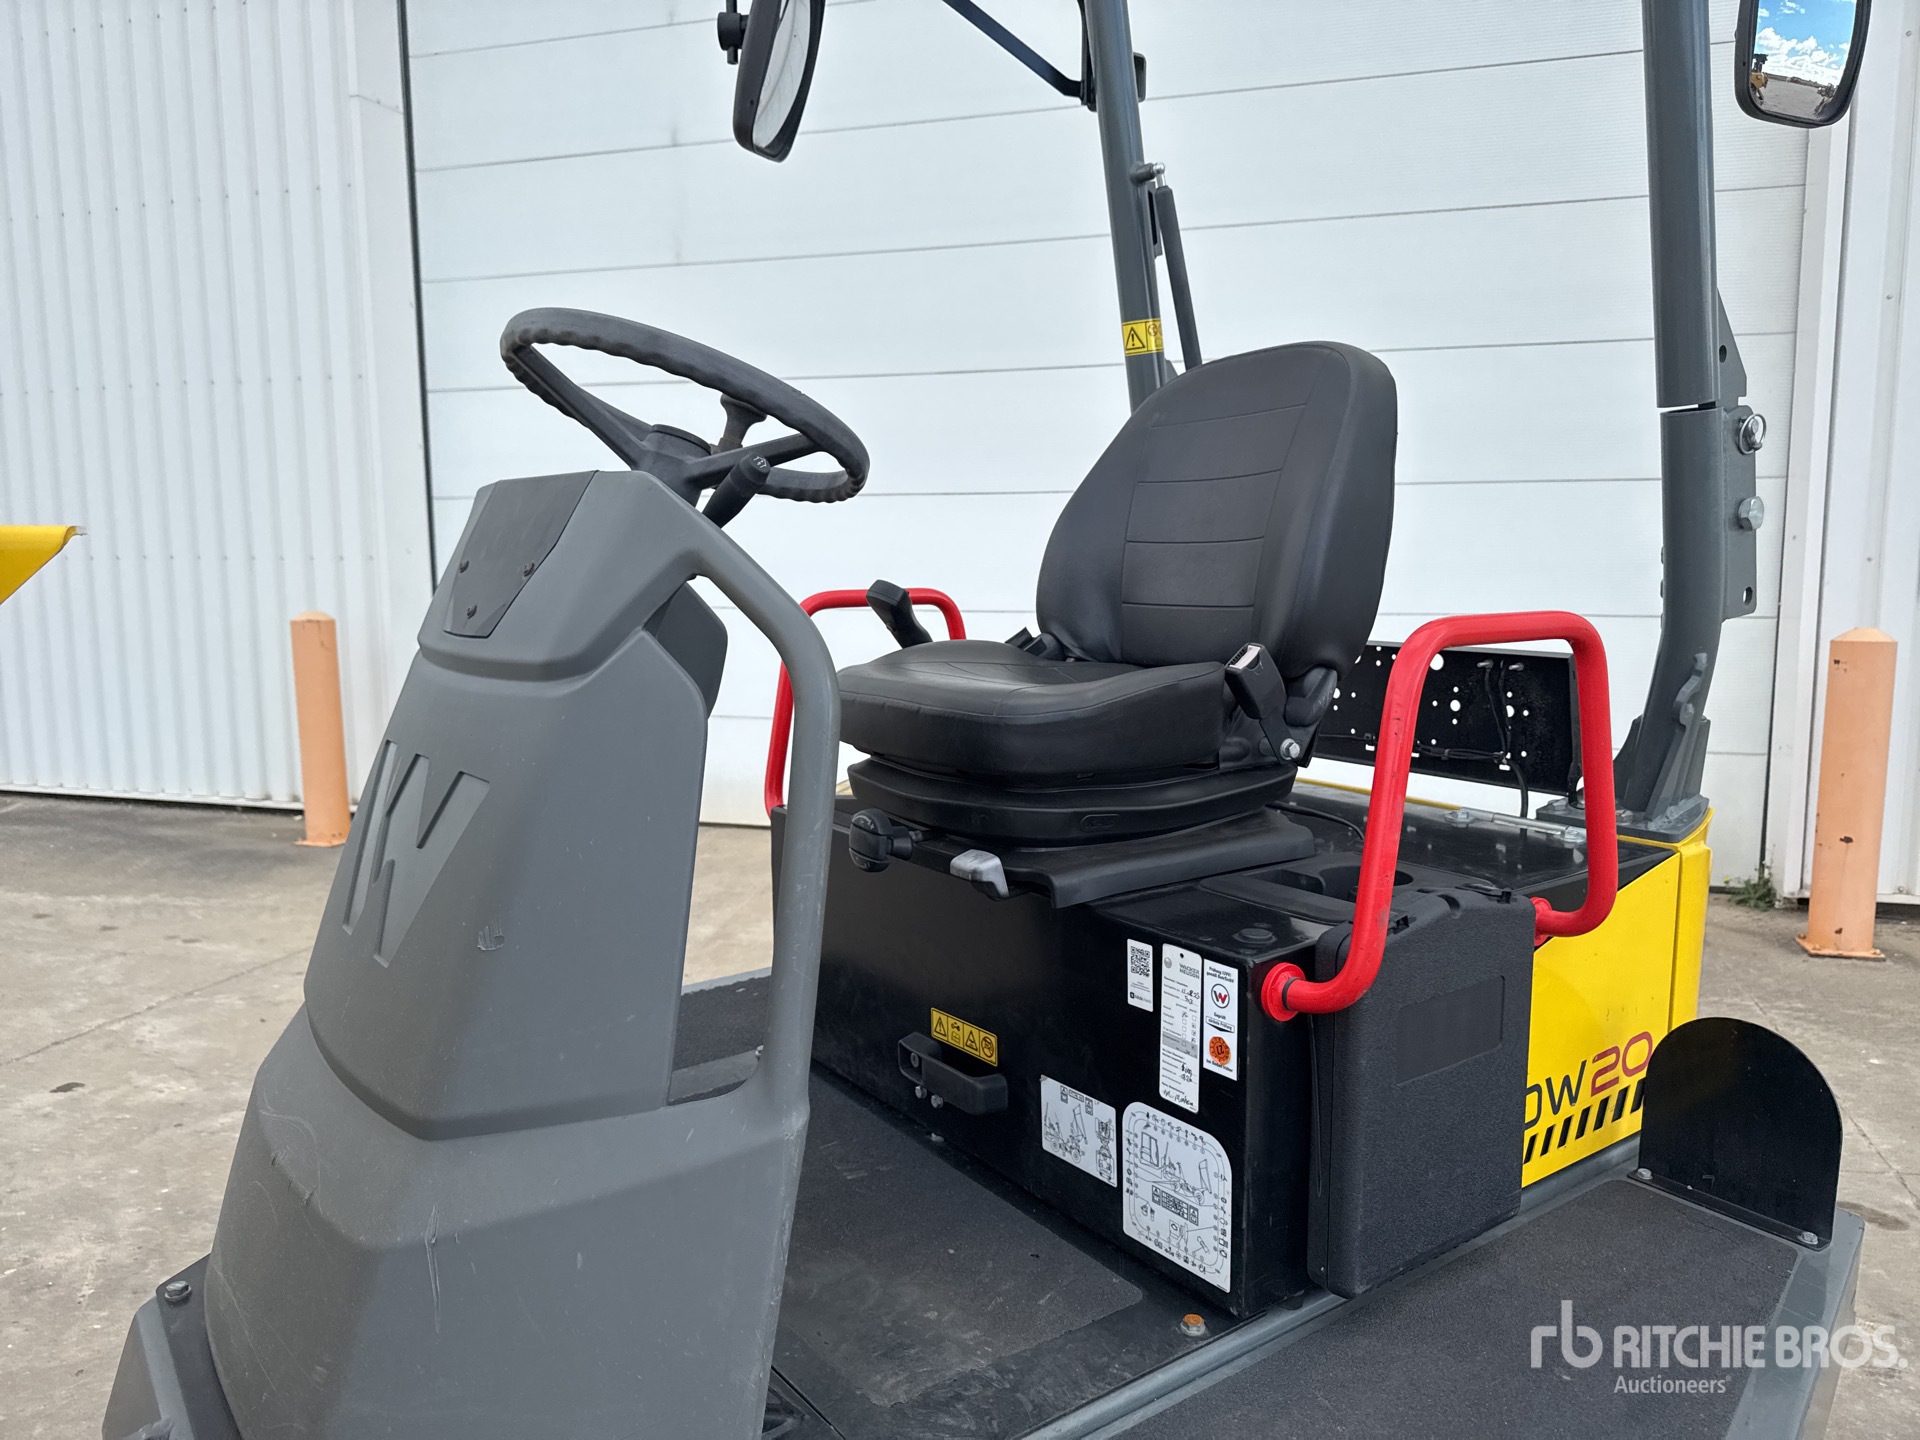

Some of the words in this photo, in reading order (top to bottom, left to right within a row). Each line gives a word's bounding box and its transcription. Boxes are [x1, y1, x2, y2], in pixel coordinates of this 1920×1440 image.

[1179, 963, 1200, 974] WACKER
[1180, 969, 1200, 980] NEUSON
[1524, 1031, 1653, 1132] DW20
